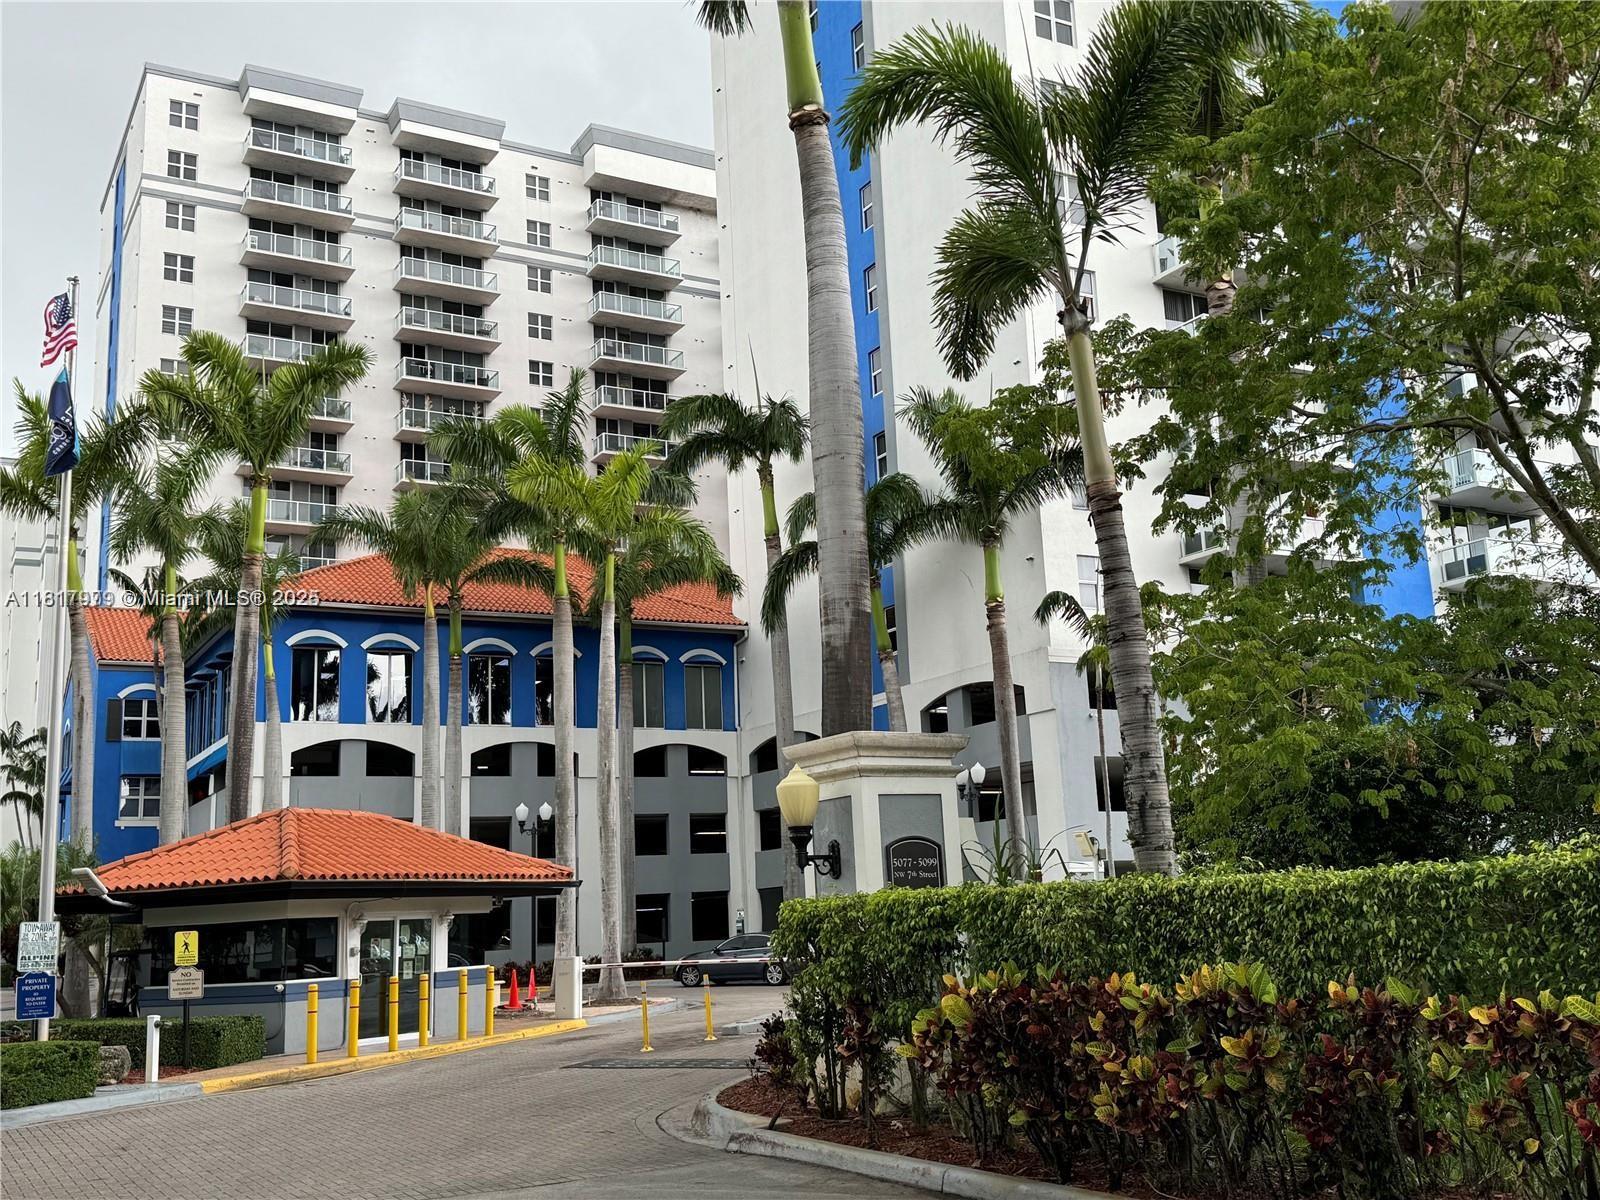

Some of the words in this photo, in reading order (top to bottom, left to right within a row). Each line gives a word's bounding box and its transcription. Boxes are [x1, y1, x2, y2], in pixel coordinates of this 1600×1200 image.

[893, 858, 912, 867] 5077
[918, 857, 937, 867] 5099
[907, 870, 917, 880] 7th
[919, 870, 937, 878] Street
[31, 932, 48, 941] ZONE
